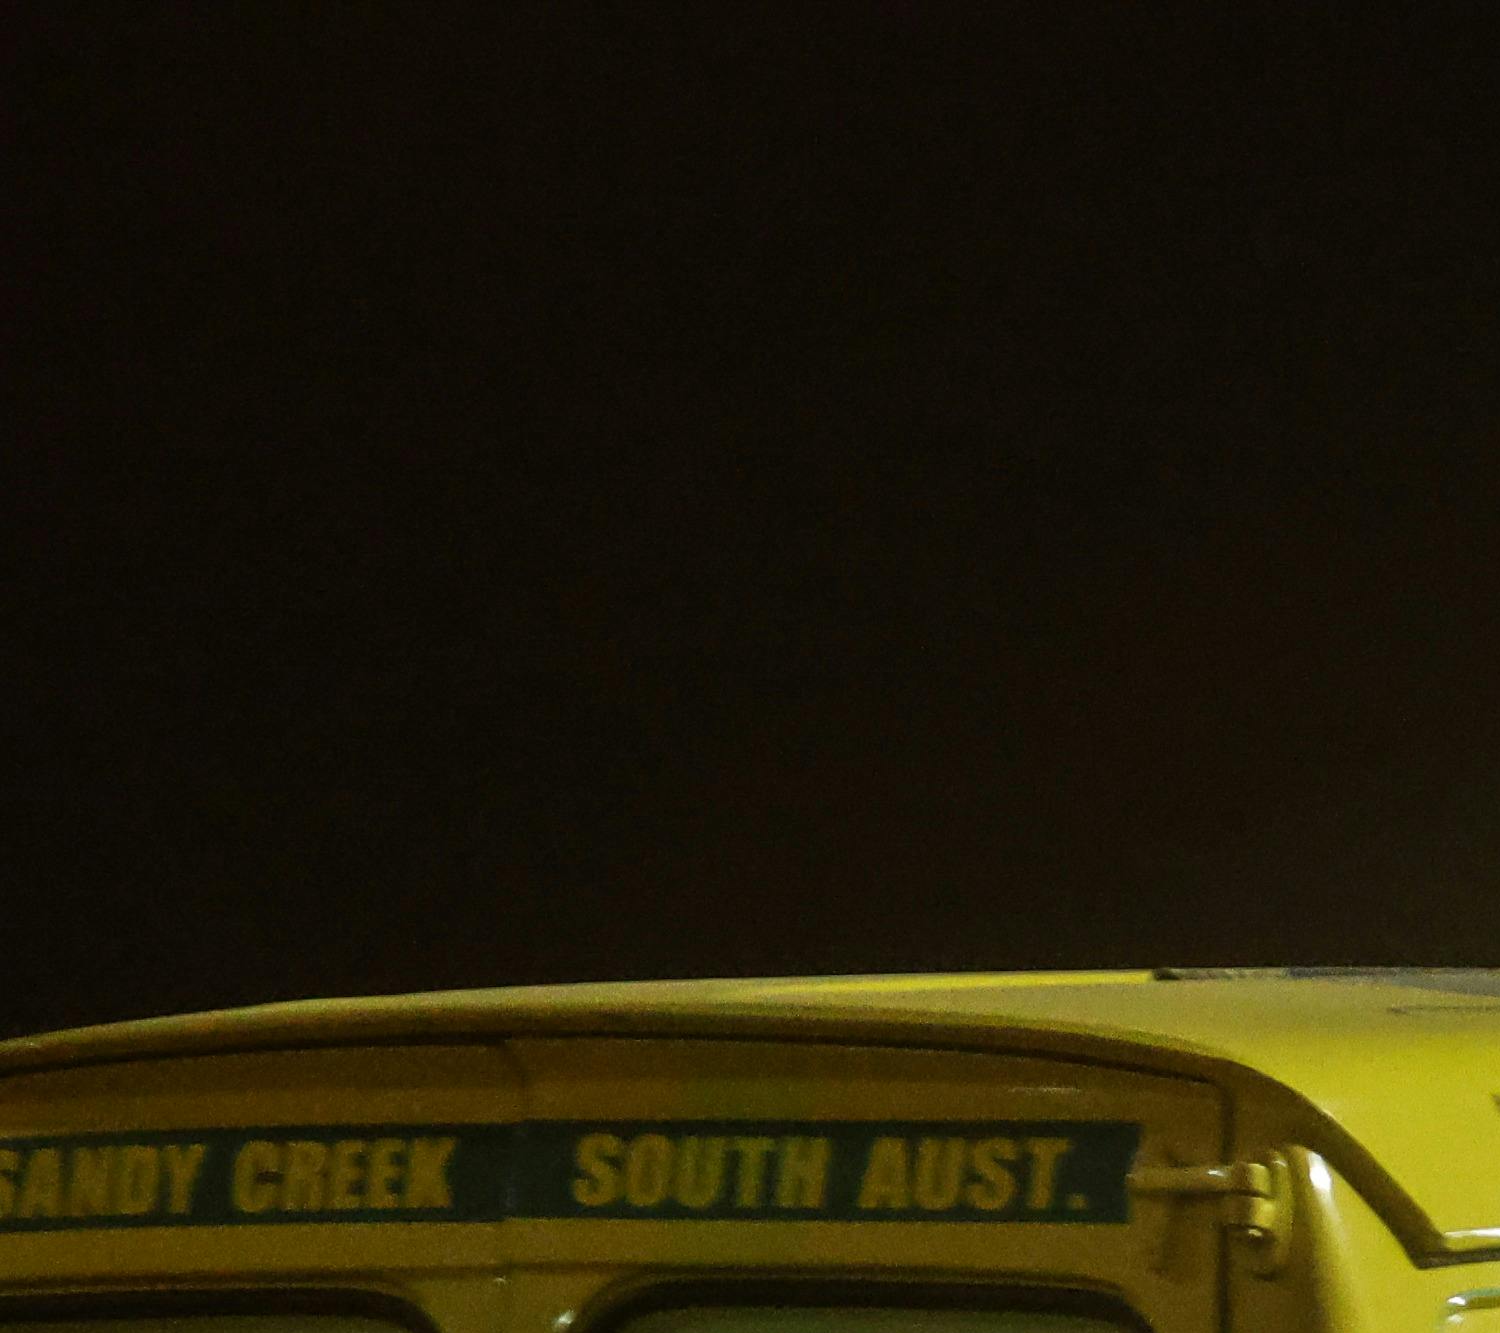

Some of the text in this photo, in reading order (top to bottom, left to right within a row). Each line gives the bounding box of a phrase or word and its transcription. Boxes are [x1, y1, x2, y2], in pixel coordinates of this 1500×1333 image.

[231, 1135, 458, 1213] CREEK
[571, 1131, 832, 1210] SOUTH
[858, 1134, 1089, 1211] AUST.
